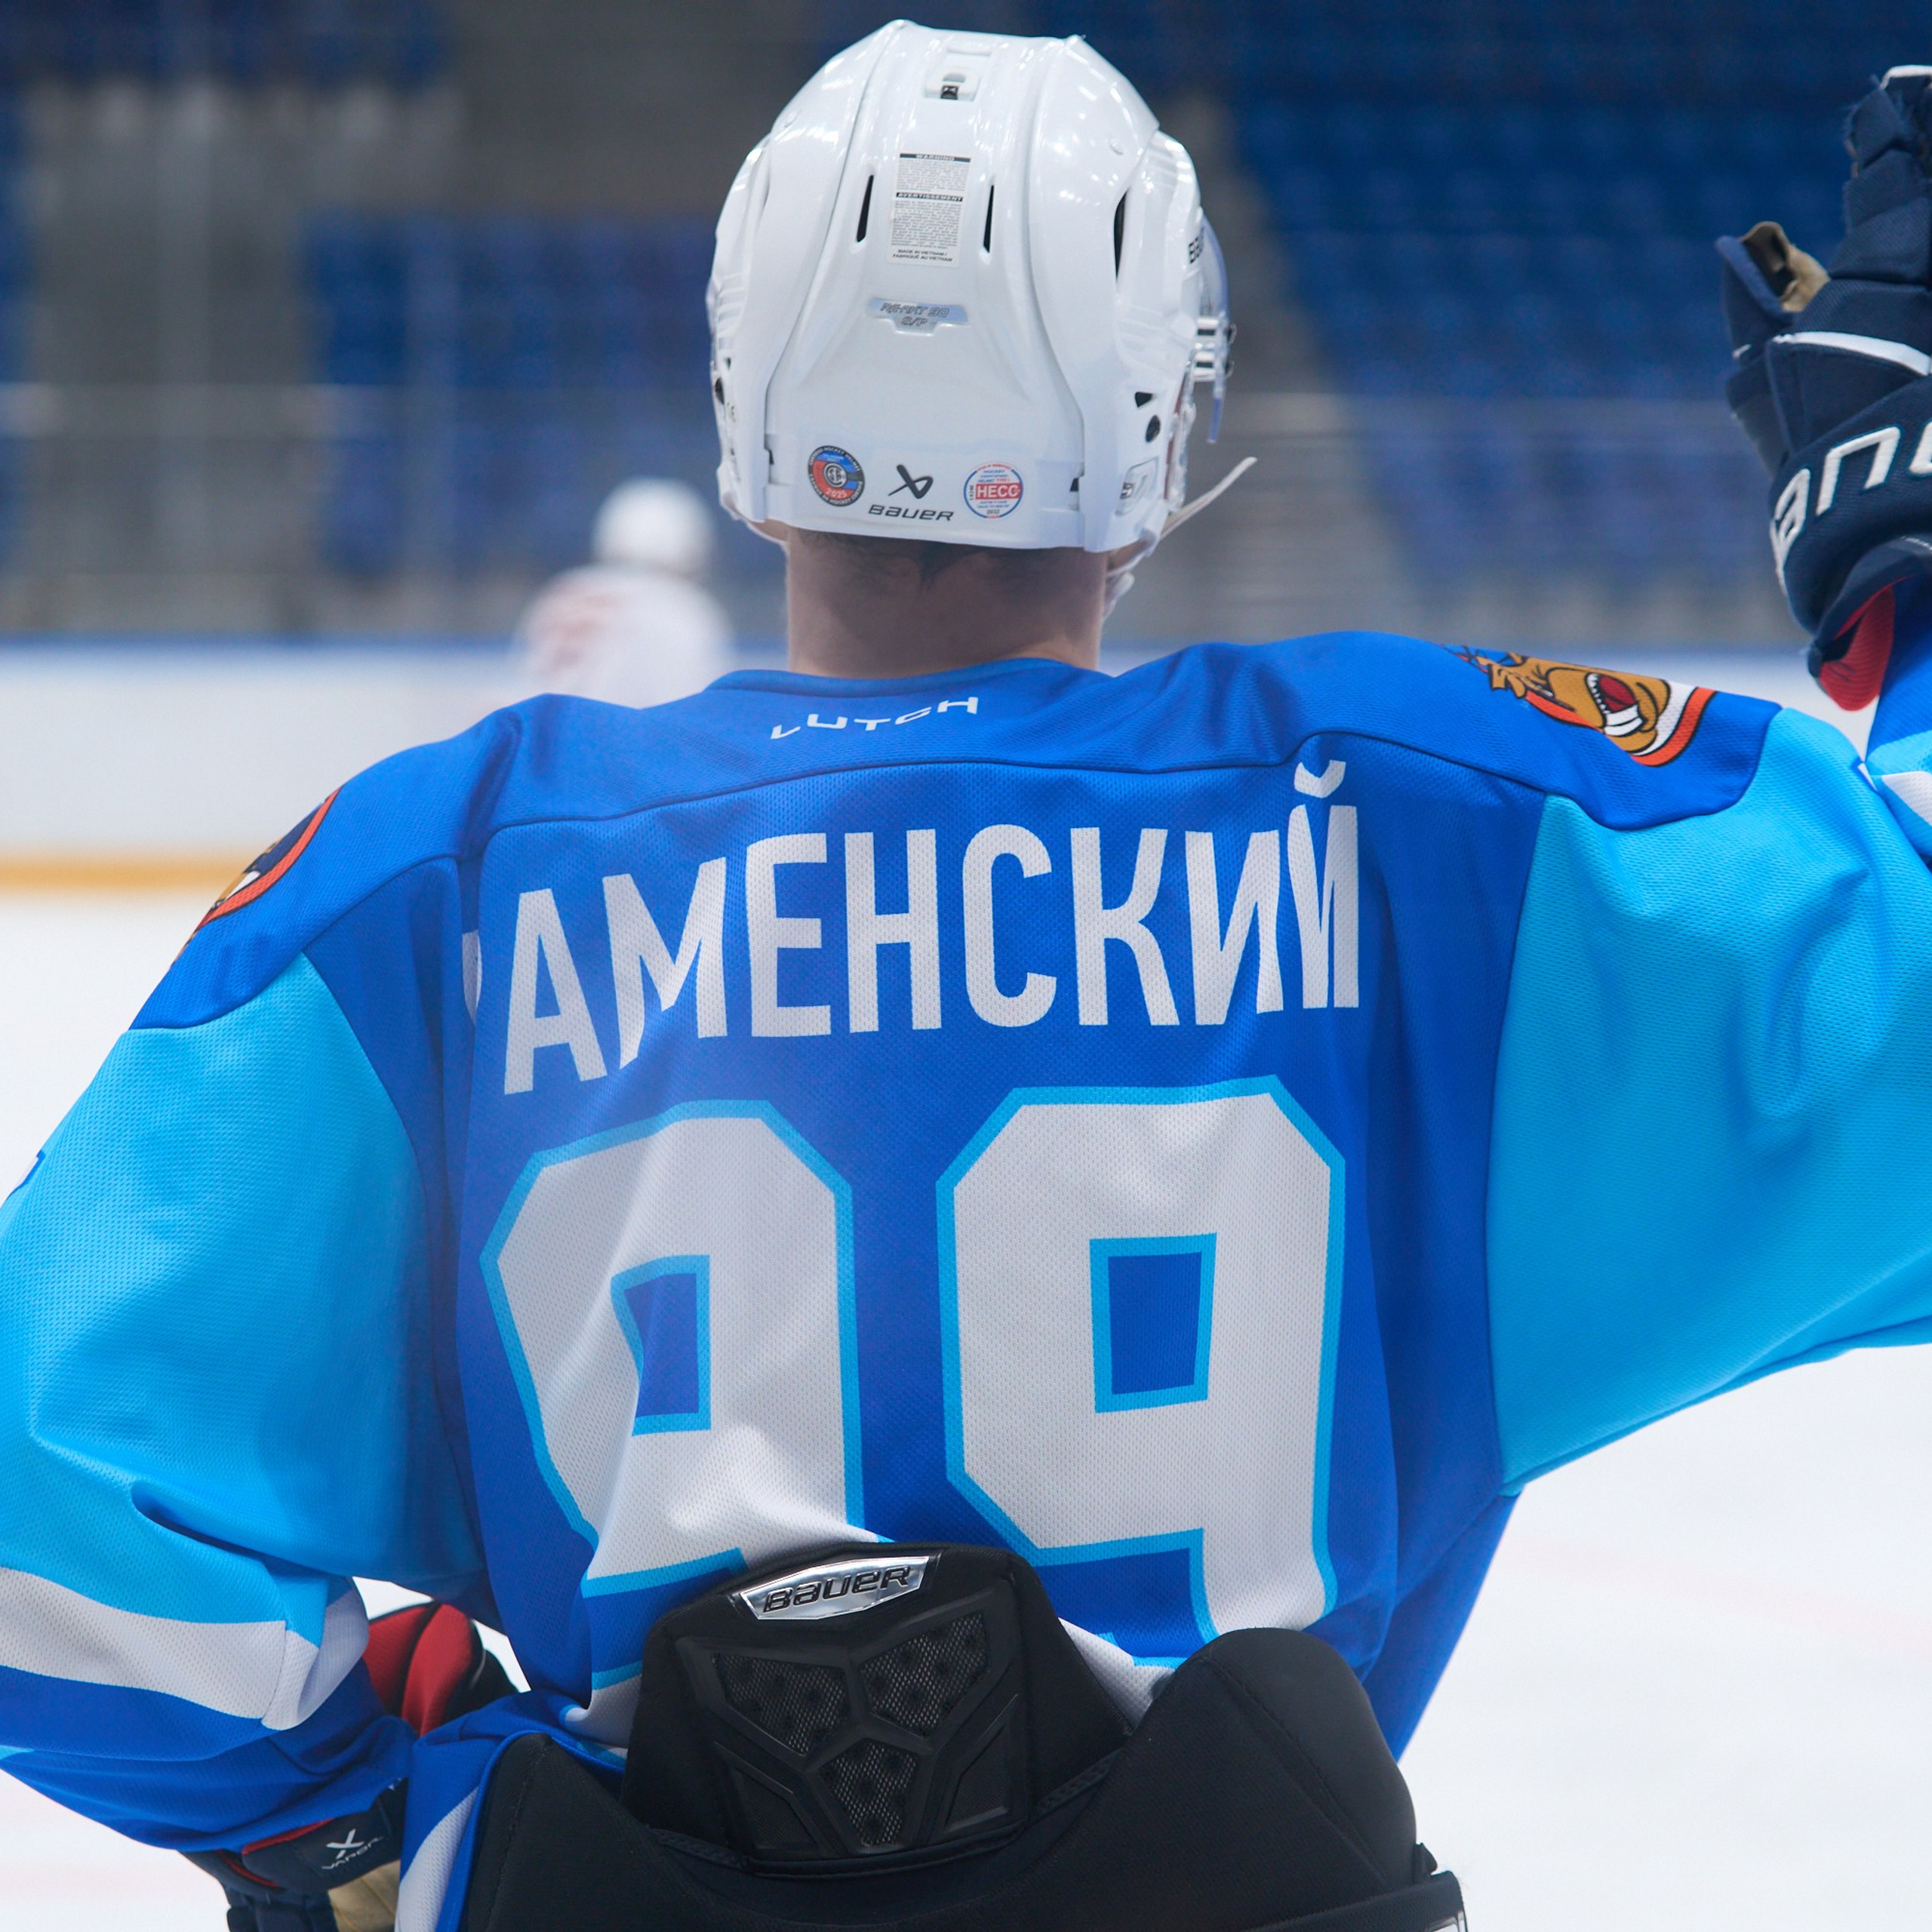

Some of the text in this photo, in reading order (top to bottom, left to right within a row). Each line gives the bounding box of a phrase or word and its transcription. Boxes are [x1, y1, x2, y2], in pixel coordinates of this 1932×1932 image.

[915, 153, 955, 162] WARNING
[898, 192, 962, 202] AVERTISSEMENT
[977, 485, 1019, 498] HECC
[462, 759, 1360, 1096] АМЕНСКИЙ
[480, 1073, 1346, 1713] 99
[762, 1564, 912, 1614] BAUER
